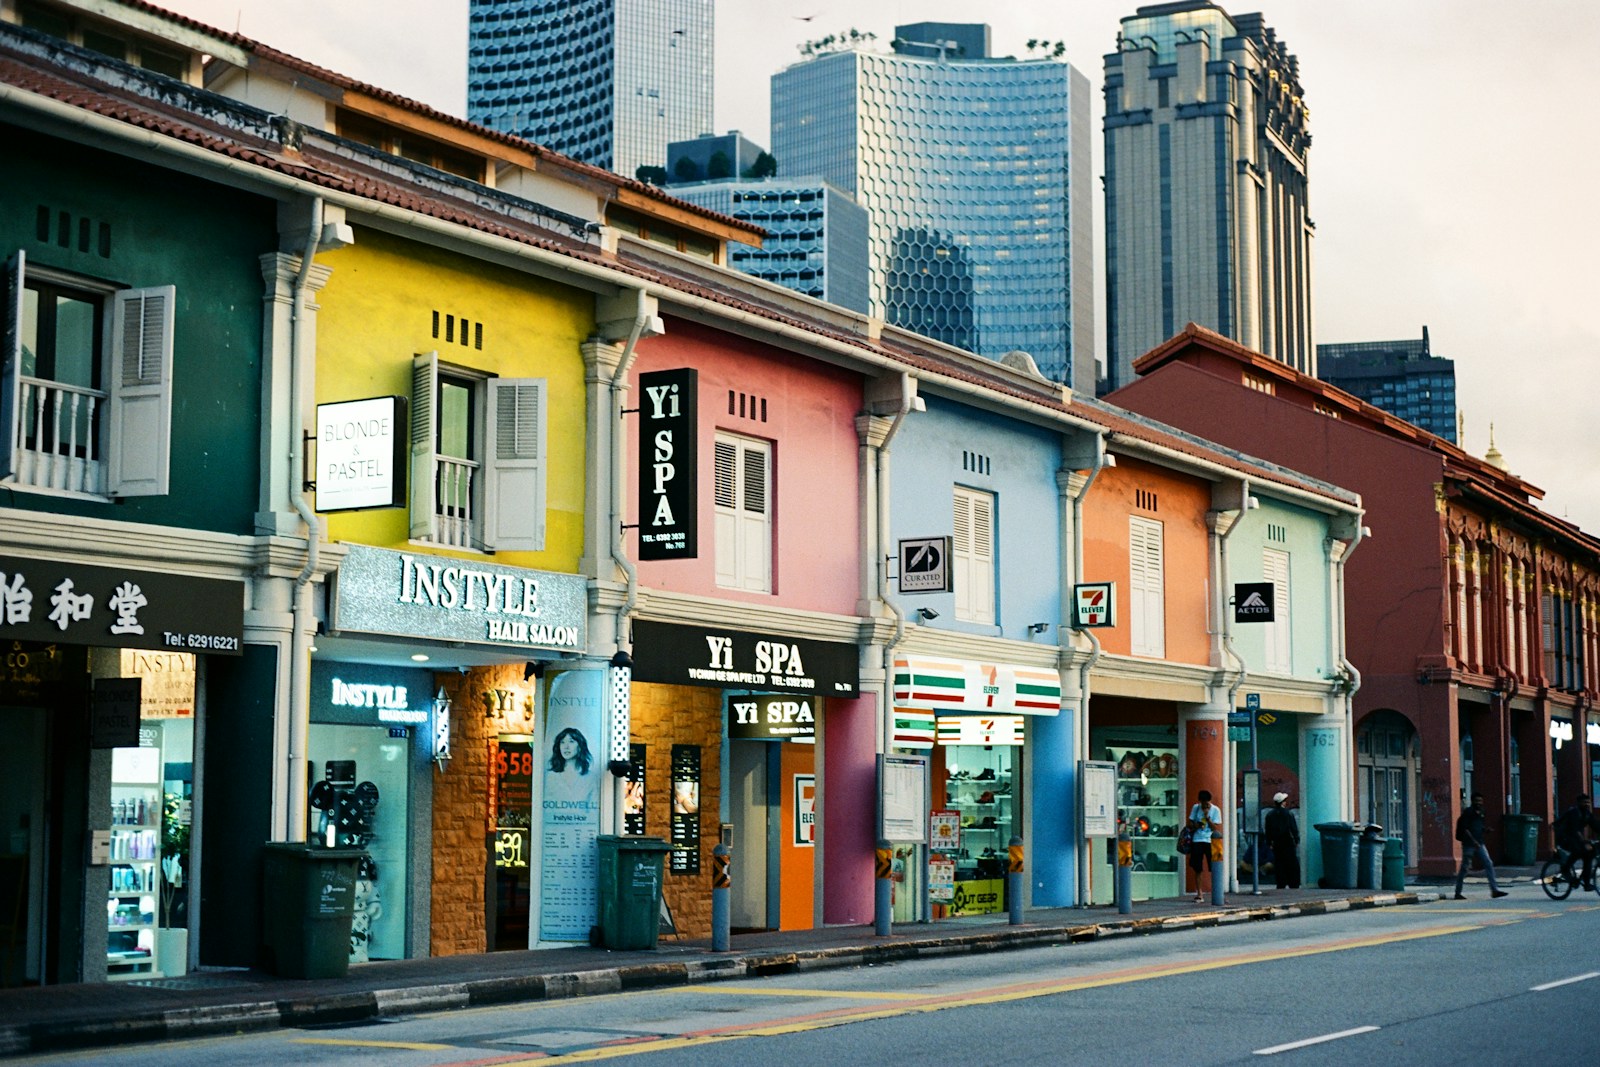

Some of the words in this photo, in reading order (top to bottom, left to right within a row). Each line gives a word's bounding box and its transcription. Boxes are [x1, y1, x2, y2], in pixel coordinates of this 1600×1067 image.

[645, 383, 681, 419] Yi
[325, 418, 389, 442] BLONDE
[352, 444, 360, 456] &
[328, 459, 384, 481] PASTEL
[651, 429, 676, 527] SPA
[642, 534, 656, 543] TEL:
[399, 554, 542, 618] INSTYLE
[905, 574, 940, 582] CURATED
[0, 571, 148, 636] 怡和堂
[1237, 606, 1270, 614] AETOS
[163, 631, 186, 647] Tel:
[187, 633, 238, 650] 62916221
[488, 619, 529, 643] HAIR
[529, 622, 578, 646] SALON
[706, 635, 733, 670] Yi
[755, 640, 804, 677] SPA
[331, 677, 409, 709] INSTYLE
[495, 689, 514, 711] Yi
[550, 696, 597, 707] INSTYLE
[734, 702, 758, 724] Yi
[767, 700, 814, 724] SPA
[1312, 733, 1335, 747] 762
[497, 749, 533, 778] $58
